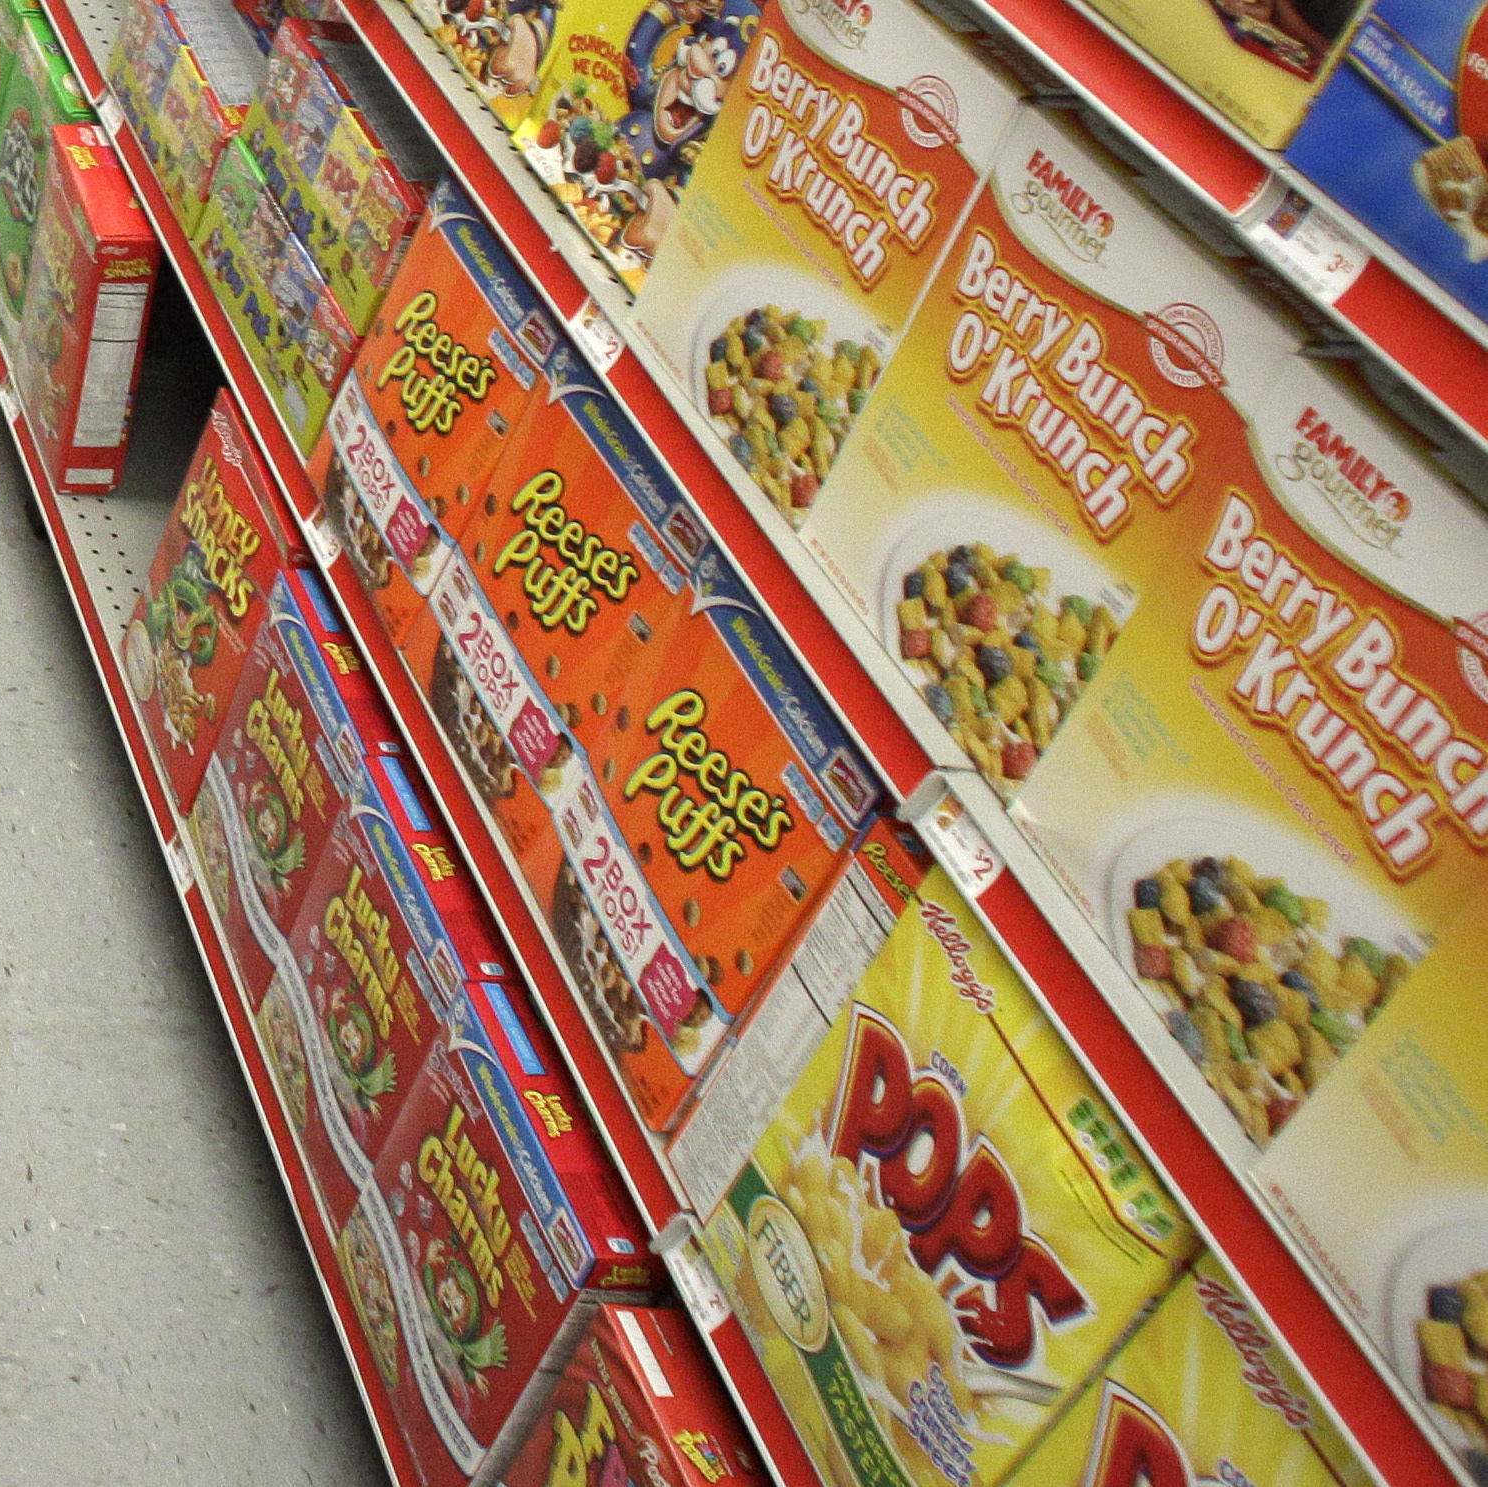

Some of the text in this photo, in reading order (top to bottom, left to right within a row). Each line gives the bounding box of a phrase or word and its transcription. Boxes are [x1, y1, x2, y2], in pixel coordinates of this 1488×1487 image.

[743, 108, 899, 276] O'Krunch
[749, 35, 931, 236] Berry Bunch
[1027, 146, 1105, 222] FAMILY
[945, 314, 1143, 526] O'Krunch
[957, 234, 1199, 492] Berry Bunch
[649, 690, 811, 844] Reese's
